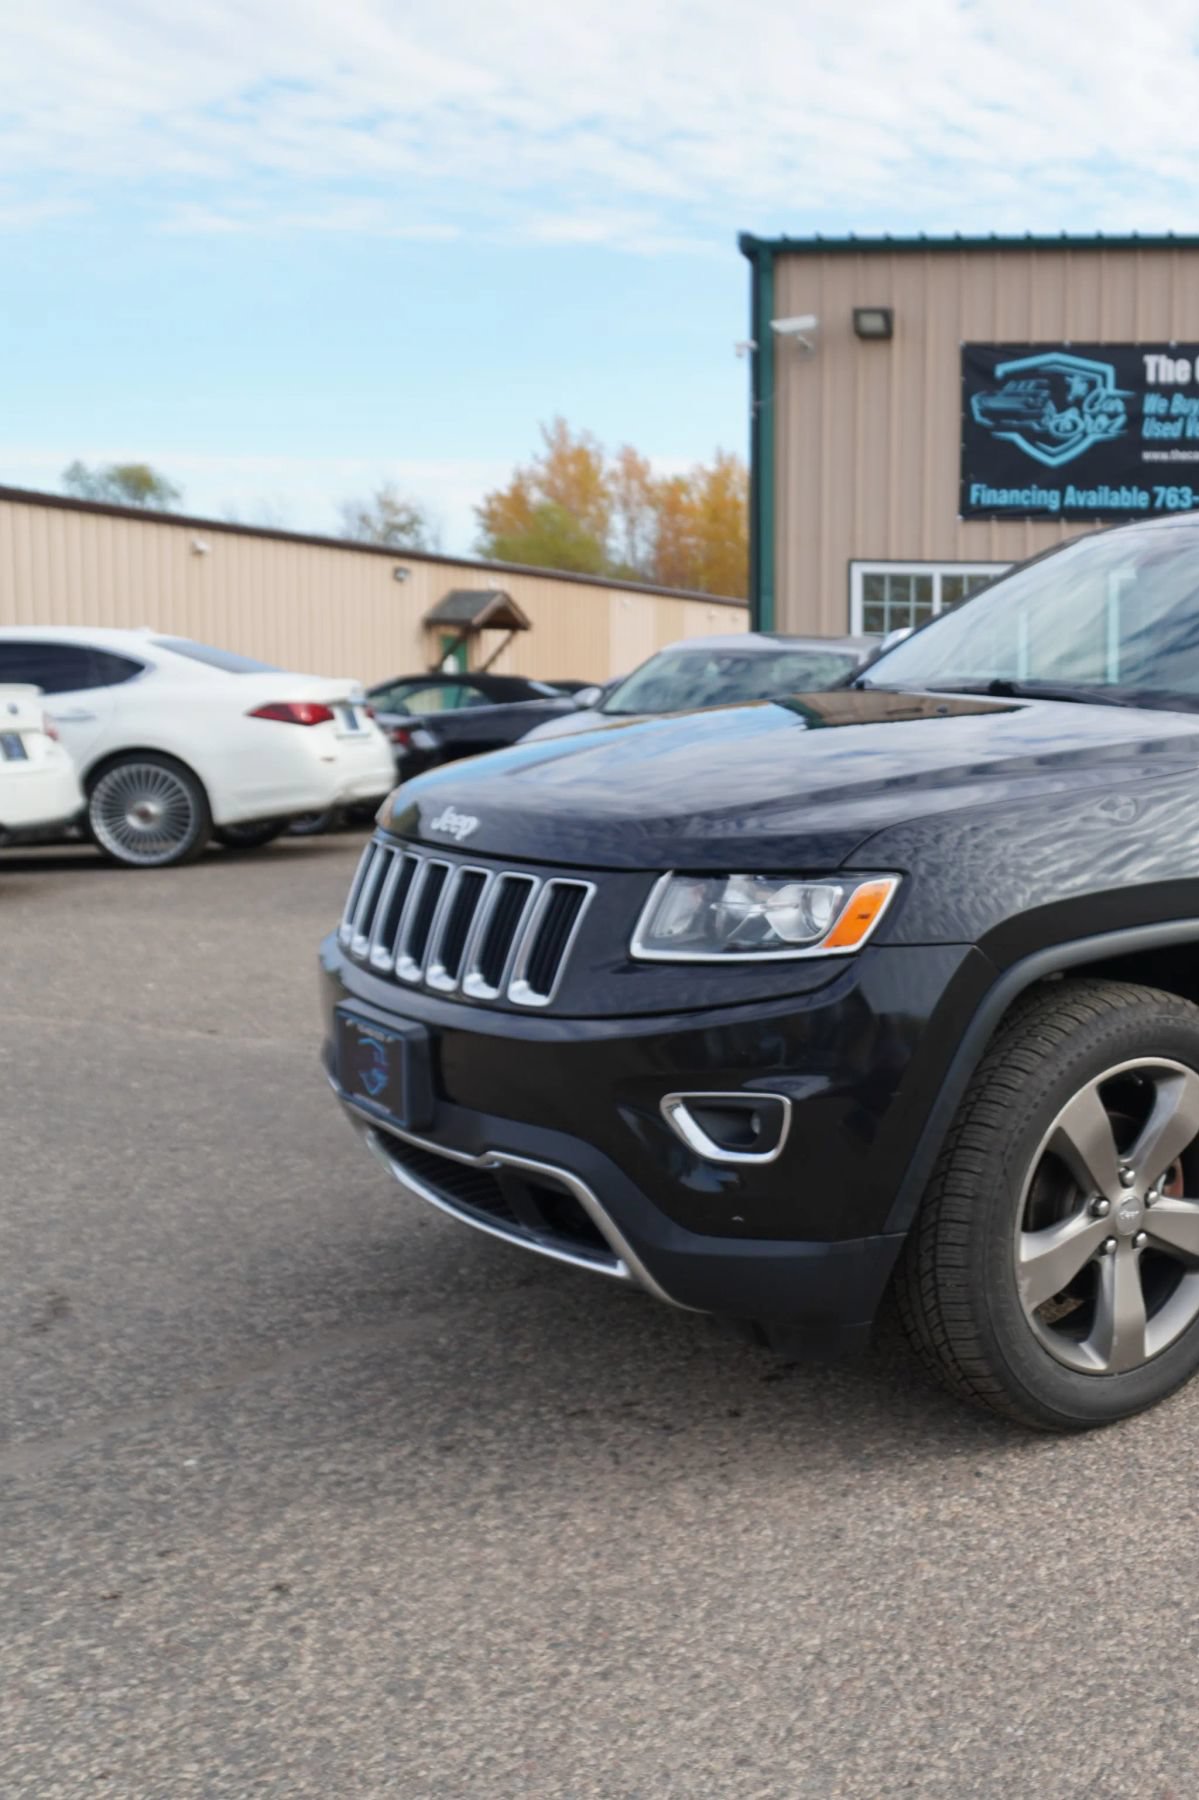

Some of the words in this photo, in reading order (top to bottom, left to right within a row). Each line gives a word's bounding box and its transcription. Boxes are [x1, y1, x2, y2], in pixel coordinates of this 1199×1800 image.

[1143, 354, 1192, 384] The
[1143, 393, 1169, 414] We
[1142, 417, 1184, 438] Used
[970, 484, 1060, 511] Financing
[1063, 486, 1150, 507] Available
[431, 805, 478, 840] Jeep
